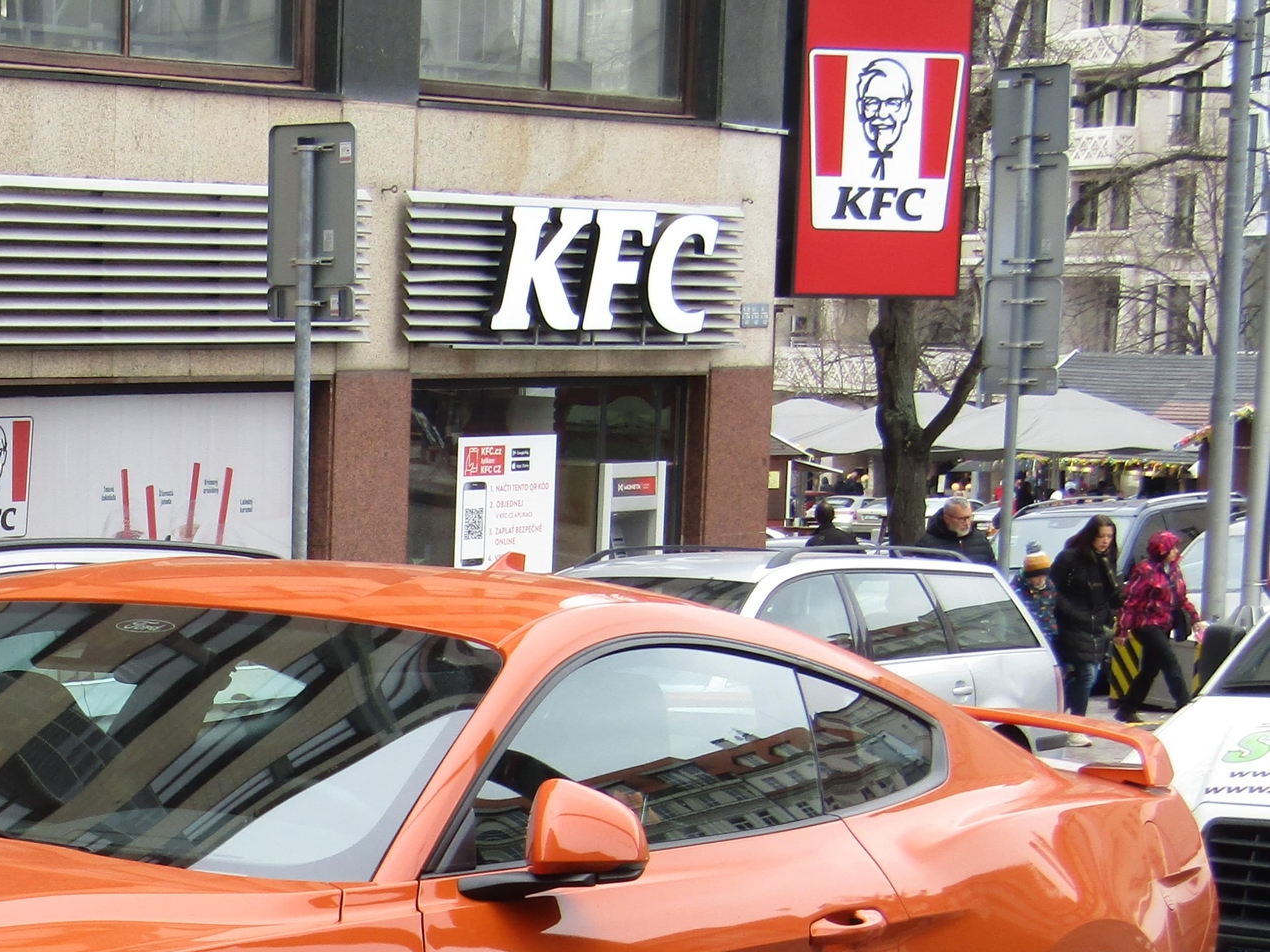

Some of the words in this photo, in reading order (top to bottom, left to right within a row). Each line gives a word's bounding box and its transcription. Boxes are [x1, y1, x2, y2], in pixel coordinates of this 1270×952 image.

[831, 186, 926, 222] KFC
[490, 205, 720, 335] KFC
[480, 446, 503, 456] KFC.cz
[480, 464, 493, 474] KFC
[493, 464, 502, 474] CZ
[512, 483, 529, 492] TENTO
[530, 482, 538, 492] QR
